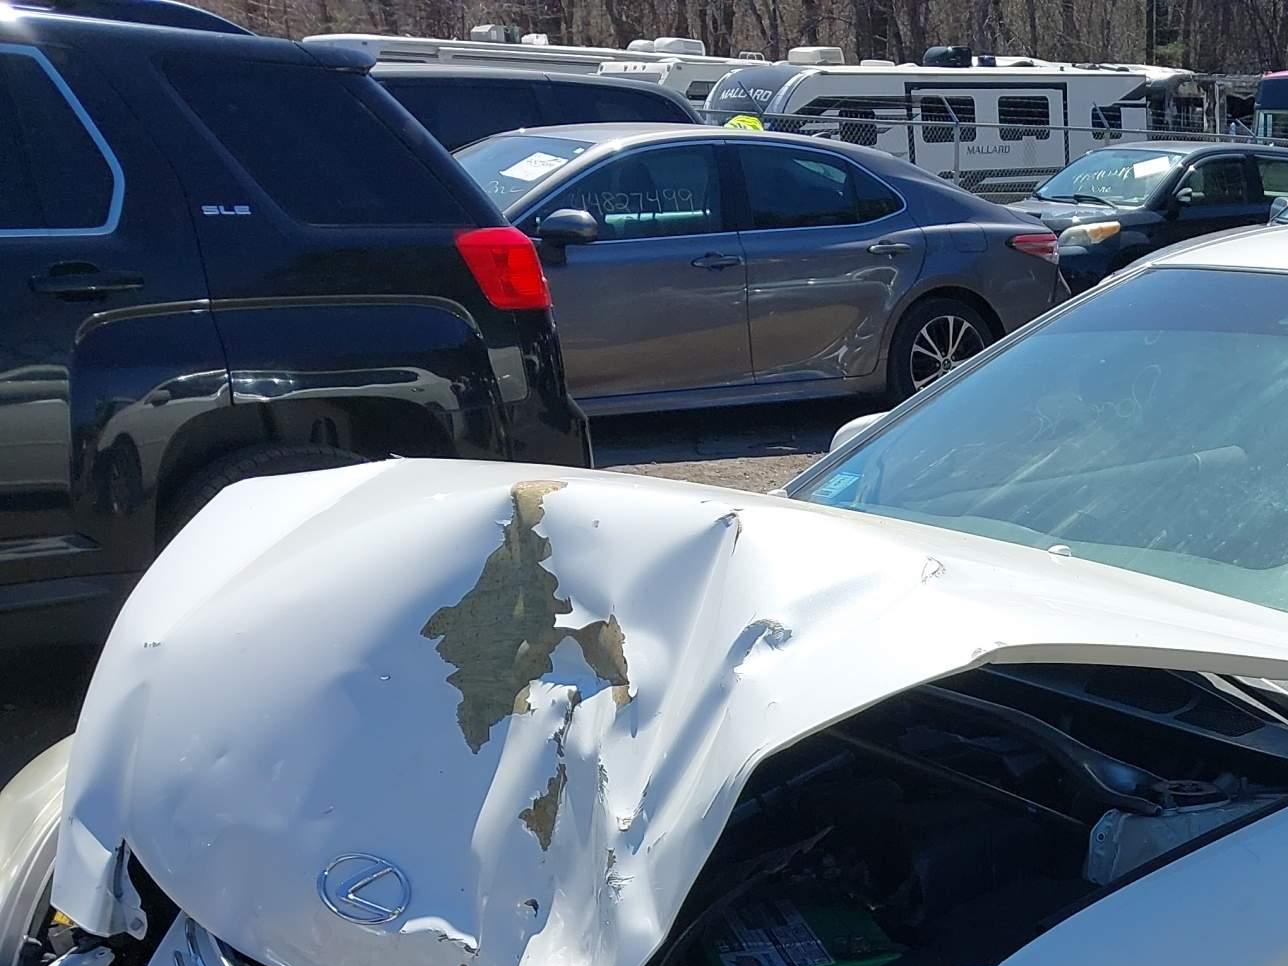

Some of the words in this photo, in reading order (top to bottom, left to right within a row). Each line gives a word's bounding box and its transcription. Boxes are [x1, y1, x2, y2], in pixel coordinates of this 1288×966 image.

[720, 87, 773, 102] MALLARD
[967, 144, 1011, 155] MALLARD
[201, 205, 252, 215] SLE
